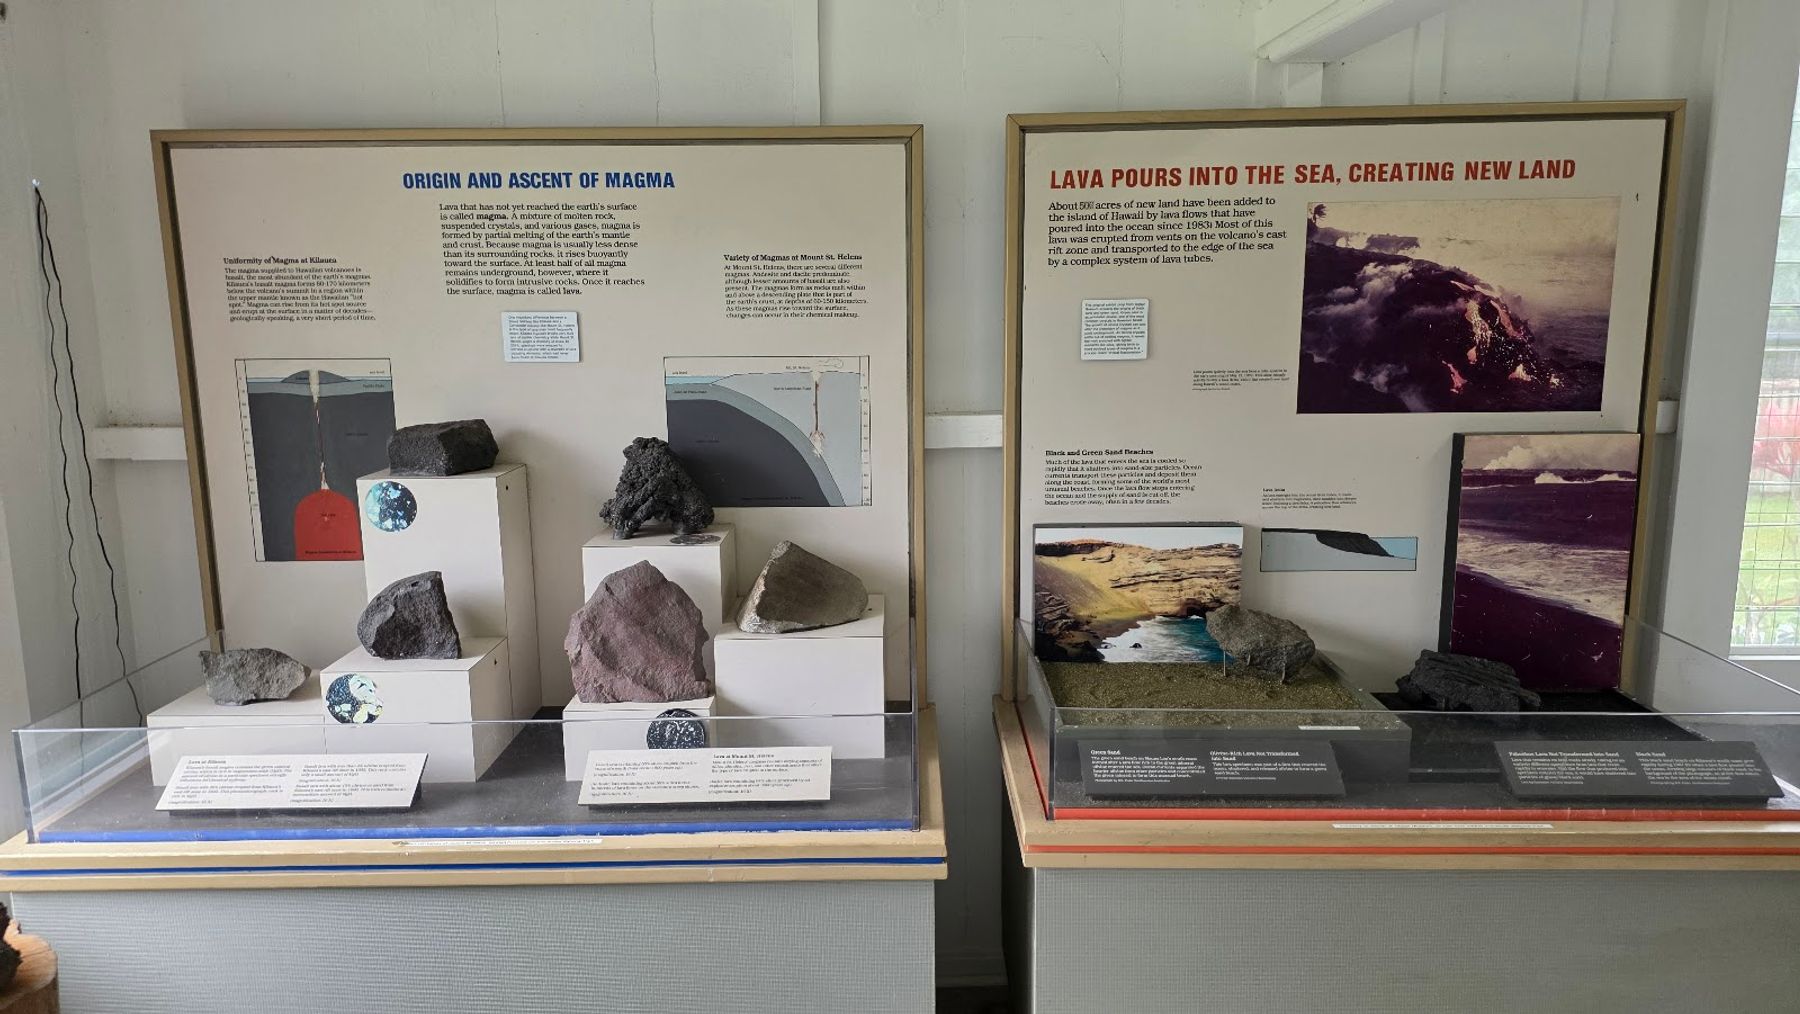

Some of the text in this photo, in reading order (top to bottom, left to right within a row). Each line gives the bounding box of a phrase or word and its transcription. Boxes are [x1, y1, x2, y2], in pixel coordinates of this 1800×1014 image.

[1050, 158, 1576, 189] LAVA POURS INTO THE SEA, CREATING NEW LAND
[403, 172, 675, 189] ORIGIN AND ASCENT OF MAGMA
[439, 203, 459, 211] Lava
[478, 203, 494, 211] has
[511, 203, 525, 212] yet
[526, 202, 560, 211] reached
[561, 202, 575, 211] the
[576, 202, 605, 211] earth's
[606, 202, 637, 210] surface
[1047, 201, 1078, 211] About
[1095, 202, 1122, 210] acres
[1123, 199, 1134, 209] of
[1158, 198, 1180, 208] land
[1181, 197, 1205, 208] have
[1206, 197, 1231, 207] been
[1233, 196, 1263, 206] added
[1265, 196, 1276, 205] to
[439, 212, 448, 220] is
[449, 212, 474, 220] called
[476, 213, 509, 221] magma.
[510, 212, 518, 220] A
[519, 212, 552, 220] mixture
[594, 212, 616, 220] rock,
[1048, 208, 1256, 222] the island of Hawaii by lava flows that have
[441, 221, 640, 232] suspended crystals, and various gases, magma is
[441, 230, 630, 241] formed by partial melting of the earth's mantle
[1048, 235, 1067, 244] lava
[1090, 233, 1128, 245] erupted
[1130, 232, 1153, 242] from
[1155, 233, 1182, 241] vents
[1184, 233, 1197, 241] on
[1200, 231, 1216, 240] the
[1218, 229, 1264, 240] volcano's
[1266, 230, 1287, 239] east
[442, 240, 458, 249] and
[485, 240, 520, 248] Because
[522, 241, 552, 249] magma
[553, 240, 562, 248] is
[563, 240, 594, 250] usually
[595, 240, 612, 248] less
[613, 240, 638, 248] dense
[1048, 241, 1274, 255] rift zone and transported to the edge of the sea
[443, 249, 628, 260] than its surrounding rocks, it rises buoyantly
[443, 258, 627, 269] toward the surface. At least half of all magma
[1047, 253, 1213, 268] by a complex system of lava tubes.
[445, 268, 478, 276] remains
[480, 268, 536, 278] underground,
[537, 268, 574, 277] however,
[445, 277, 483, 286] solidifies
[516, 277, 553, 286] intrusive
[554, 277, 580, 286] rocks.
[581, 277, 603, 285] Once
[605, 277, 611, 285] it
[613, 277, 645, 285] reaches
[446, 287, 460, 295] the
[461, 286, 494, 295] surface,
[496, 288, 526, 296] magma
[536, 286, 561, 295] called
[562, 286, 582, 295] lava.
